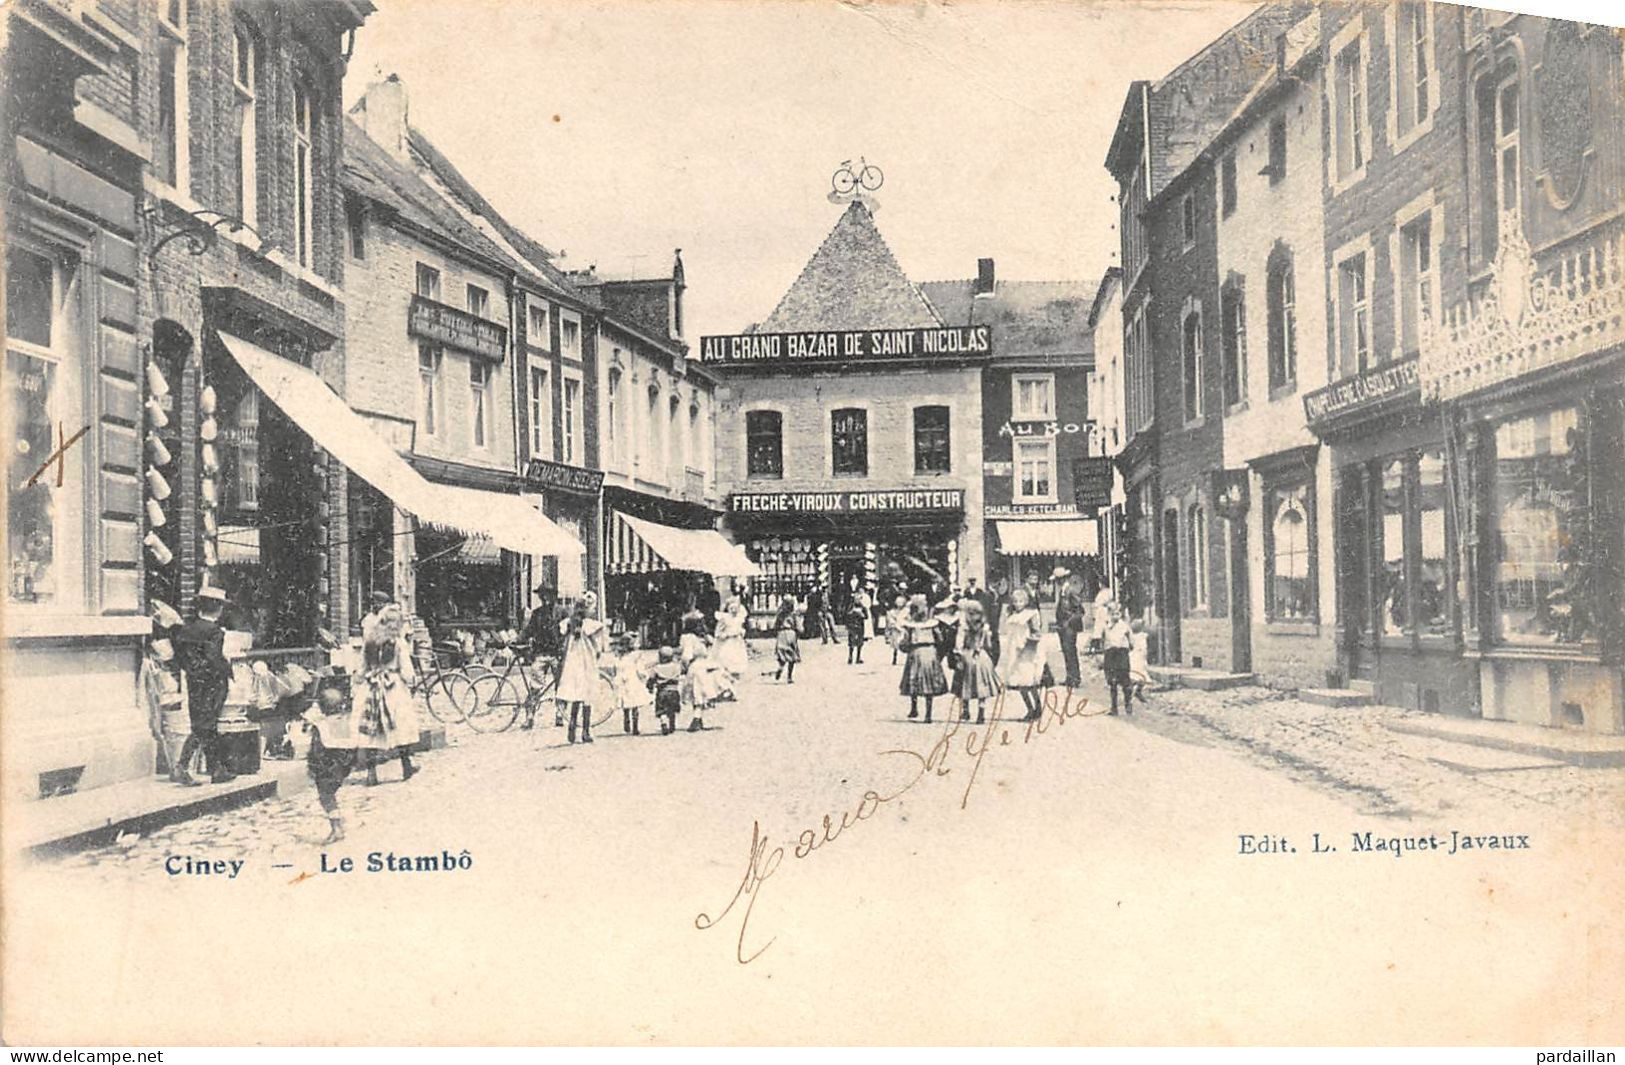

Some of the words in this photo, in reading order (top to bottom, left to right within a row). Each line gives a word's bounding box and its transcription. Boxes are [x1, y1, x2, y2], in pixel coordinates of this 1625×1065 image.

[704, 337, 725, 360] AU
[731, 335, 780, 359] GRAND
[788, 333, 837, 357] BAZAR
[844, 332, 863, 356] DE
[871, 331, 915, 354] SAINT
[922, 328, 988, 352] NICOLAS
[849, 491, 961, 511] CONSTRUCTEUR
